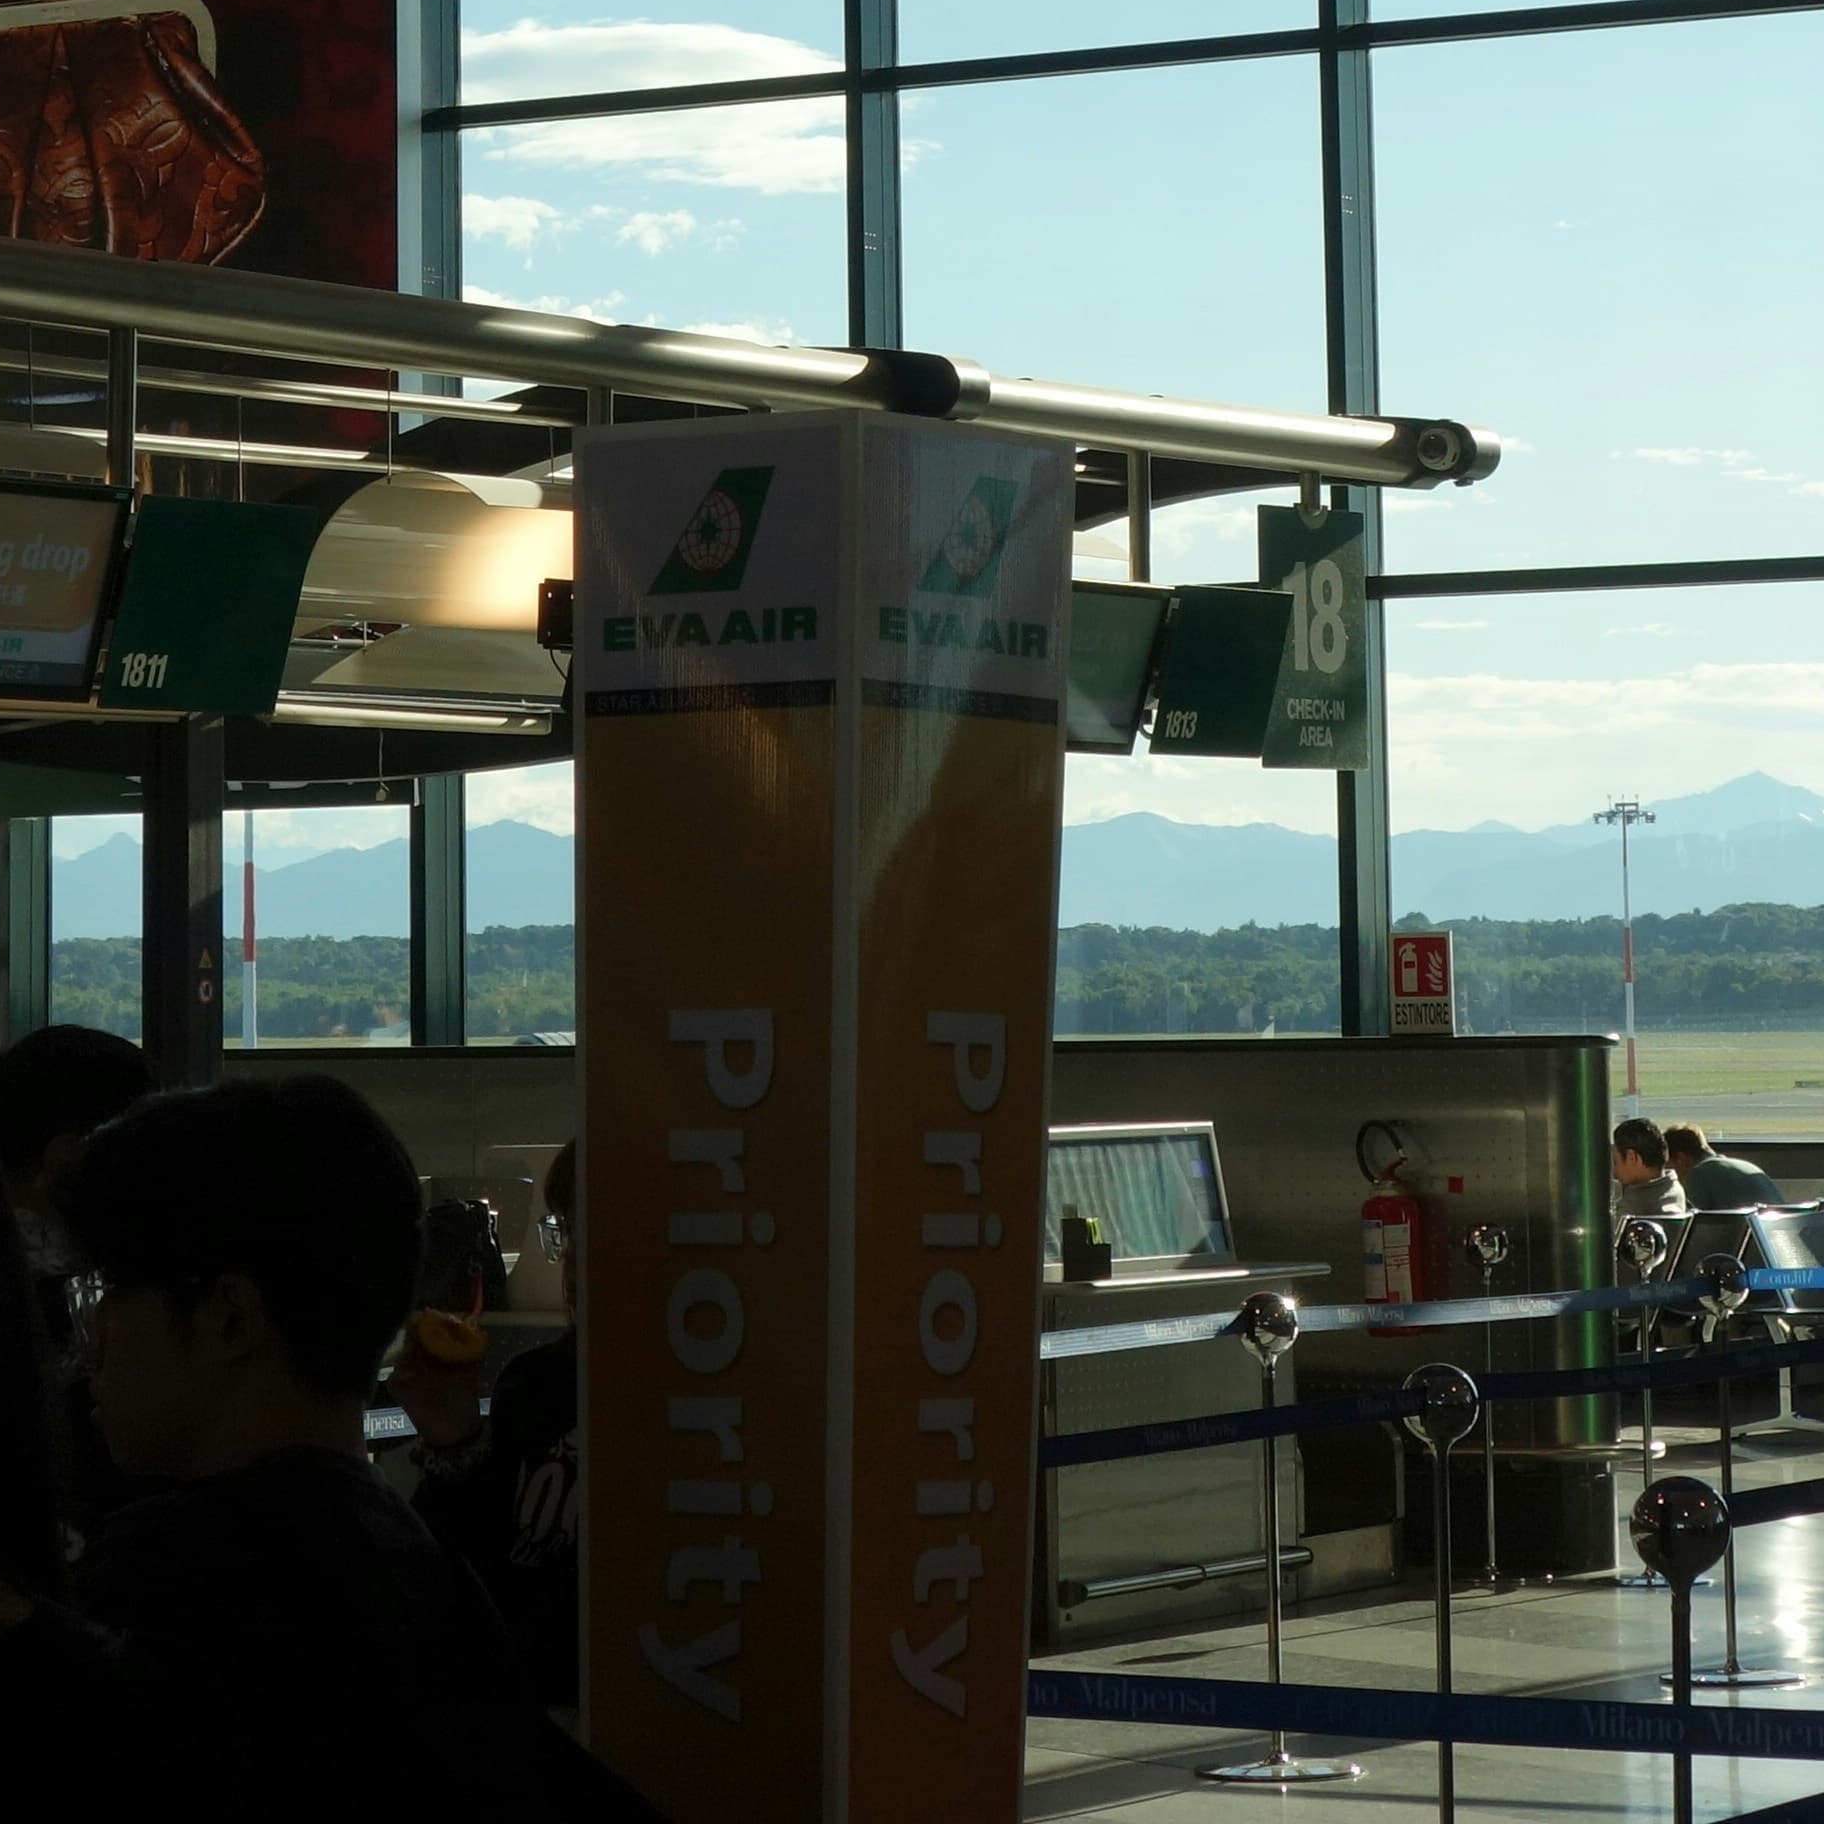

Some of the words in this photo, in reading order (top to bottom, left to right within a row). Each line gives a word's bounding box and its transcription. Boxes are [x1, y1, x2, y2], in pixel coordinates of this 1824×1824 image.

[21, 532, 91, 583] drop
[1281, 559, 1347, 674] 18
[120, 652, 169, 689] 1811
[1164, 709, 1197, 739] 1813
[1286, 697, 1346, 723] CHECK-IN
[1298, 724, 1334, 749] AREA
[1395, 1002, 1449, 1026] ESTINTORE
[638, 1007, 778, 1723] Priority
[888, 1008, 1007, 1721] Priority
[363, 1412, 405, 1438] lpensa
[1078, 1675, 1217, 1719] Malpensa
[1579, 1703, 1686, 1742] Milano
